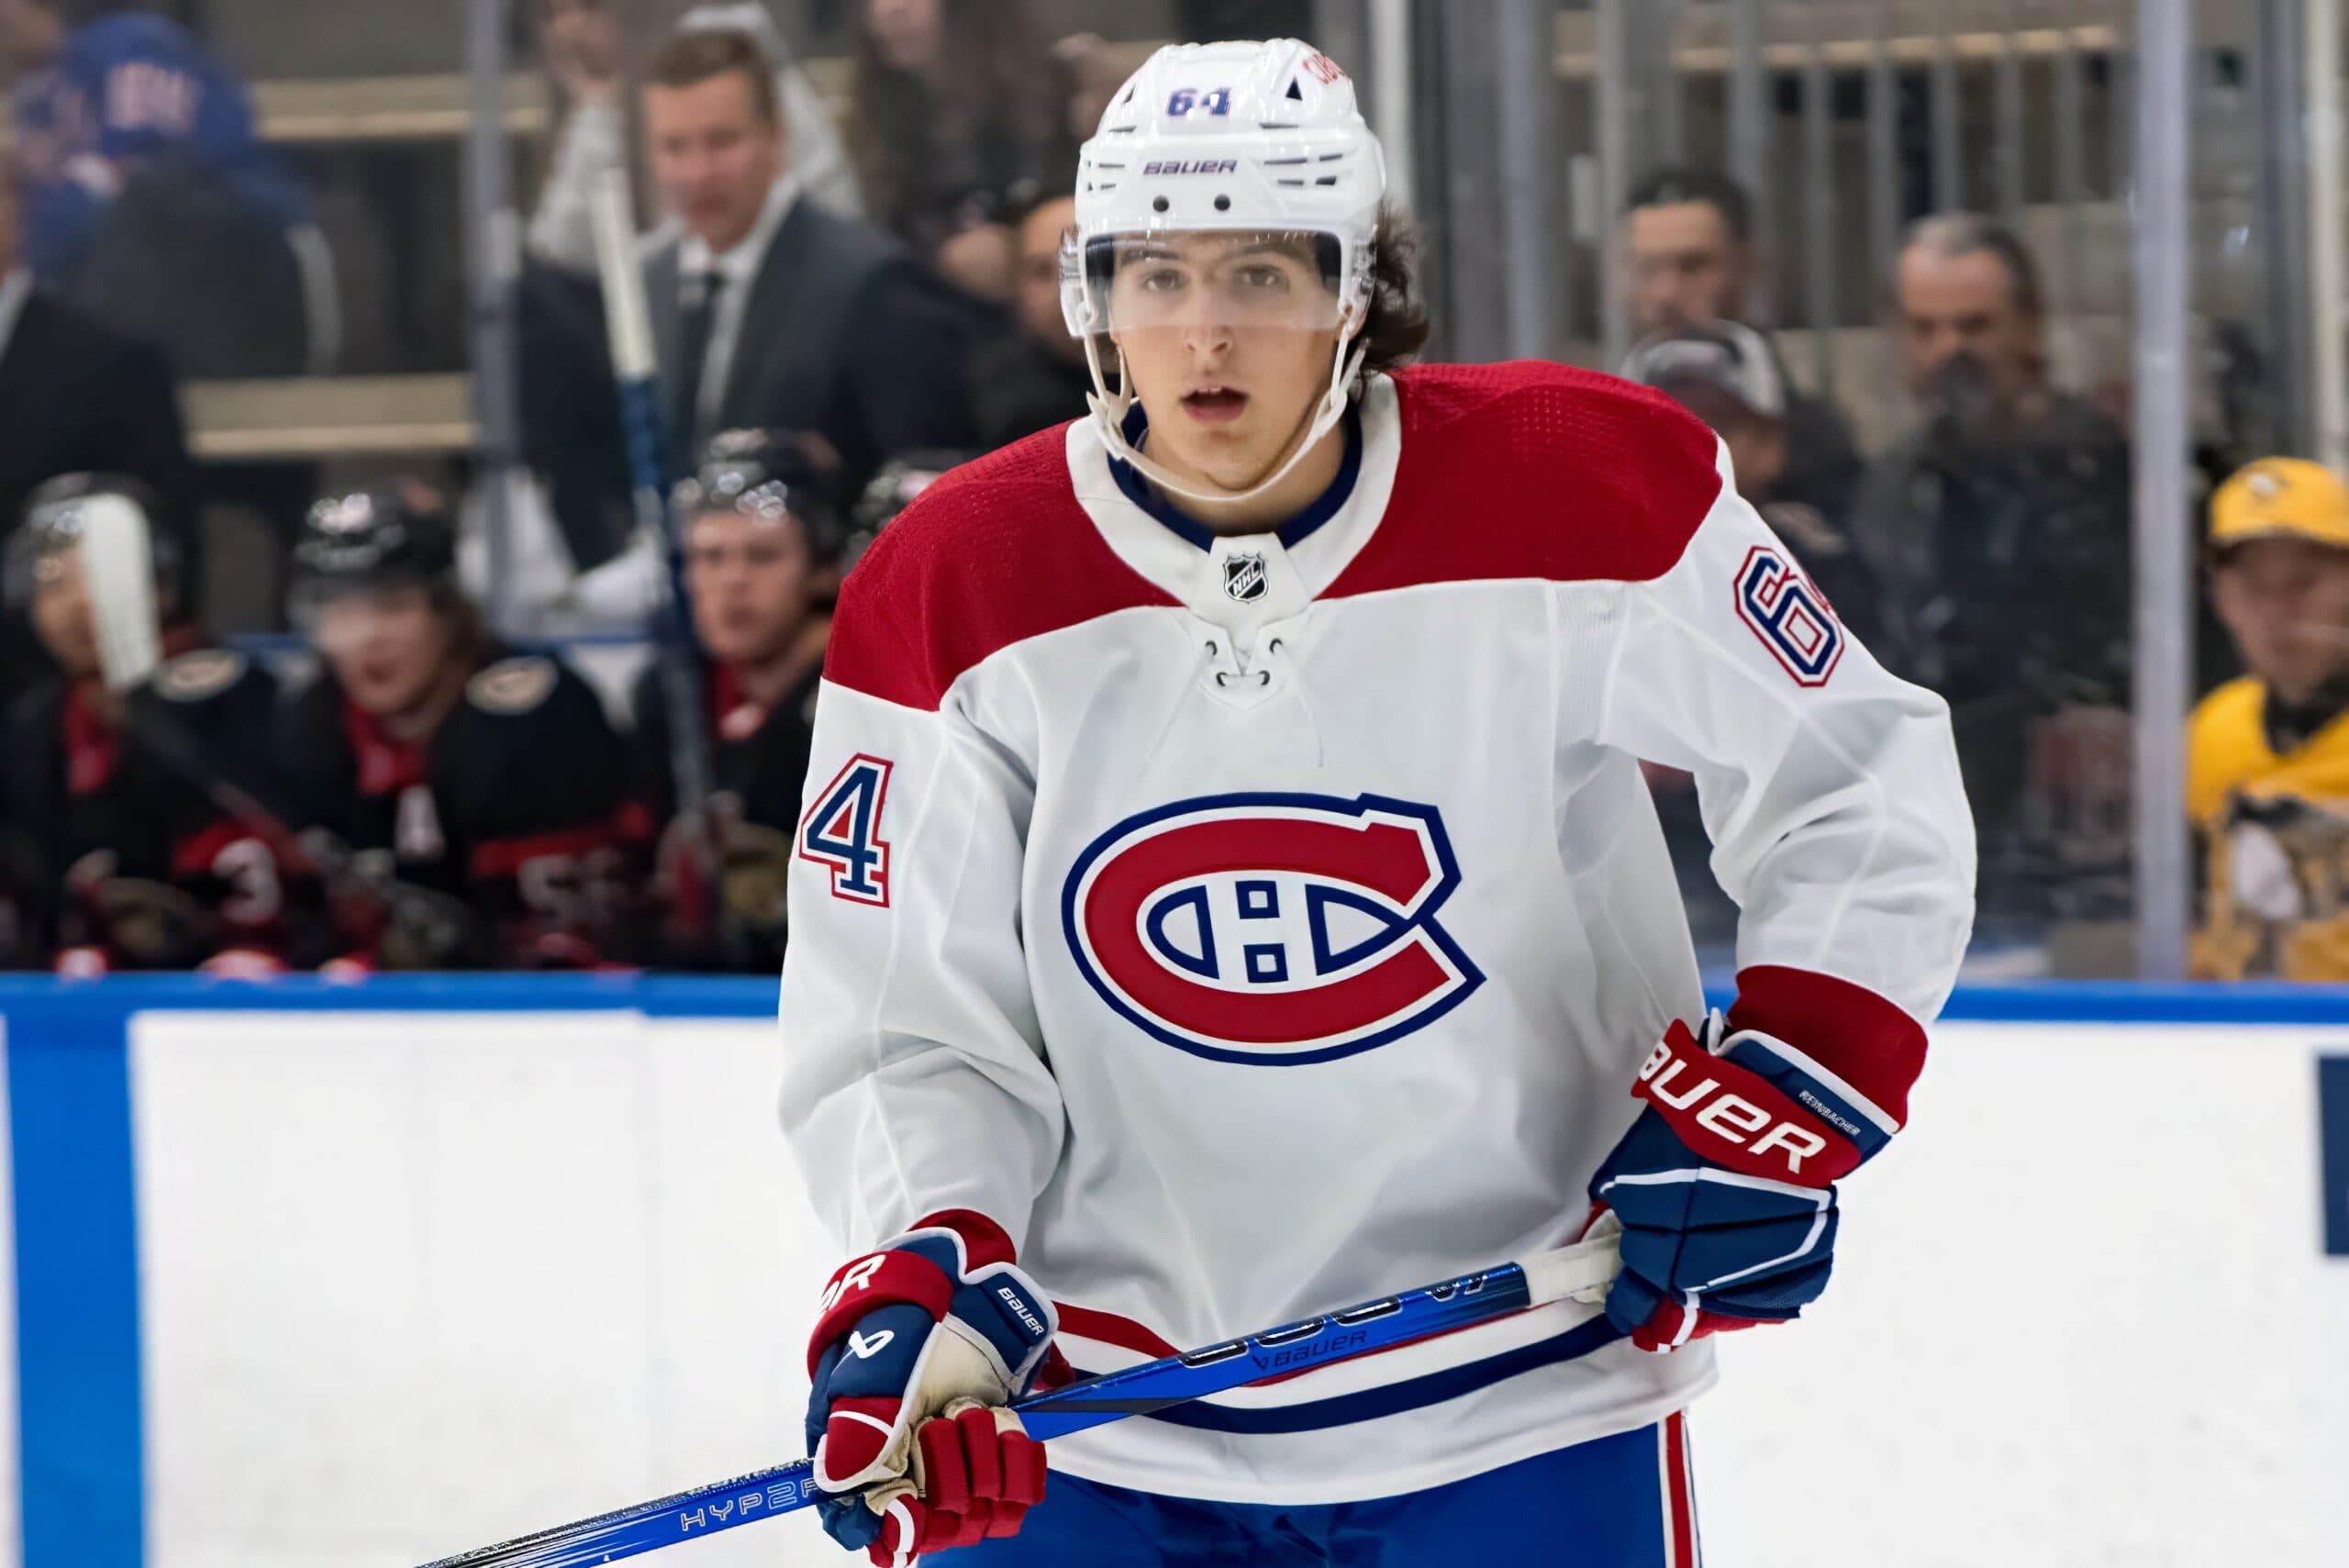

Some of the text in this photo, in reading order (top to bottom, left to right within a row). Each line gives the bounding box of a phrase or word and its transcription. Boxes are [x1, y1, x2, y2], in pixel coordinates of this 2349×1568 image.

[1166, 86, 1231, 117] 64
[1231, 562, 1262, 597] NHL
[1732, 545, 1845, 688] 6
[997, 1286, 1046, 1336] BAUER
